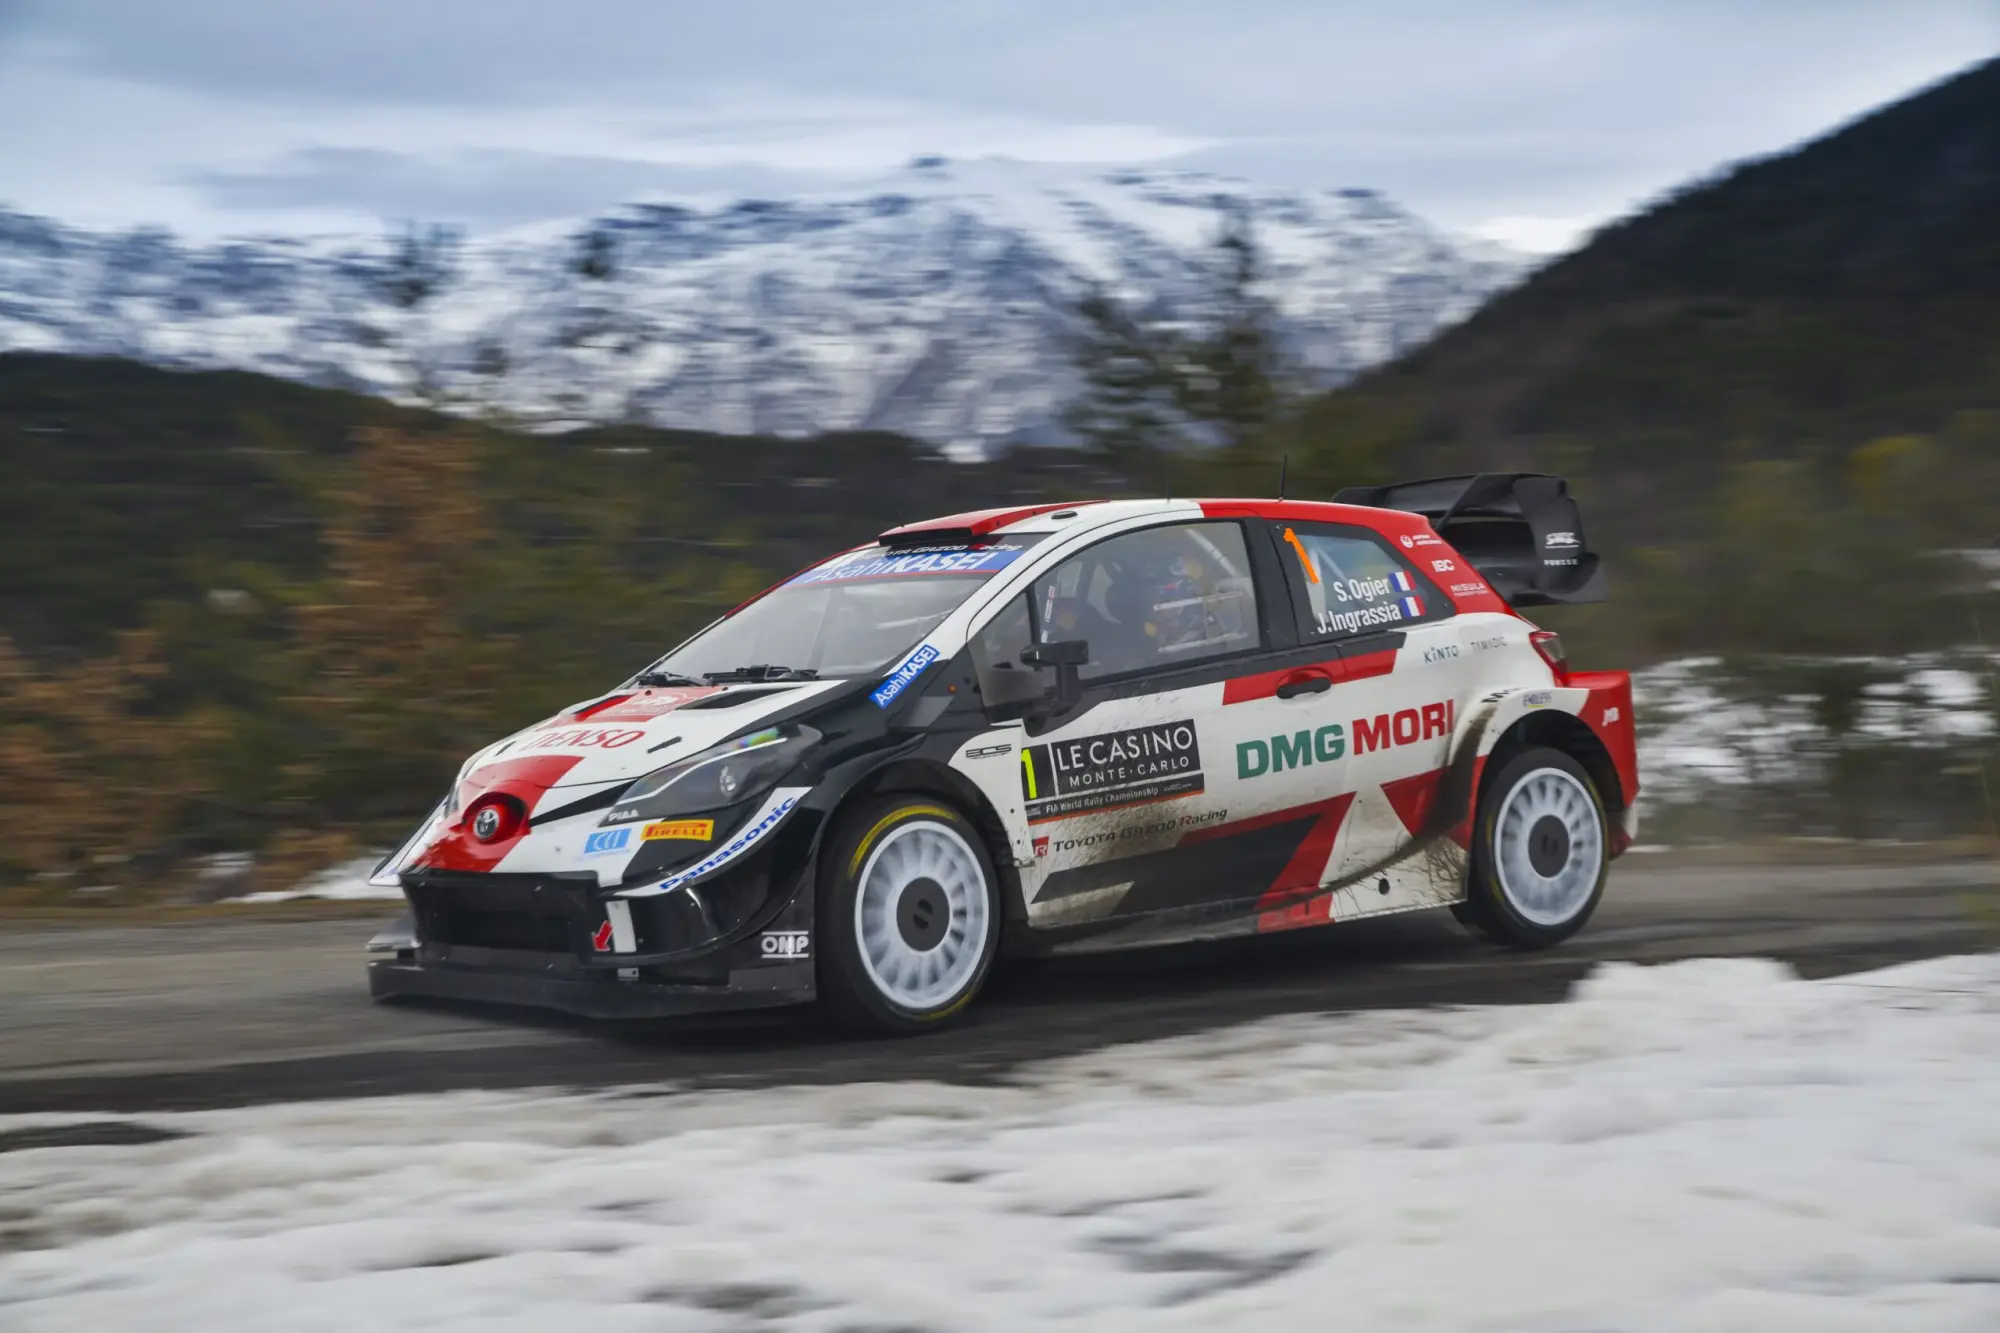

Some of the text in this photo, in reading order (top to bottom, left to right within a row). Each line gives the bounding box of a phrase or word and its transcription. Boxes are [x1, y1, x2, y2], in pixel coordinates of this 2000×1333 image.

[804, 551, 1000, 583] AsahiKASEI
[1283, 527, 1320, 584] 1
[1333, 576, 1391, 603] S.Ogier
[1317, 600, 1403, 635] J.Ingrassia
[875, 646, 938, 706] AsahiKASEI
[520, 728, 646, 751] DENSO
[1057, 726, 1193, 771] LE CASINO
[1236, 699, 1455, 780] DMG MORI
[1020, 748, 1037, 799] 1
[1069, 756, 1190, 787] MONTE CARLO
[609, 809, 639, 821] PIAA
[1046, 803, 1060, 814] FIA
[1060, 798, 1084, 811] World
[645, 823, 708, 838] PIRELLI
[659, 796, 797, 890] Panasonic
[1053, 831, 1116, 852] TOYOTA
[1179, 808, 1228, 827] Racing
[761, 935, 810, 955] OMP
